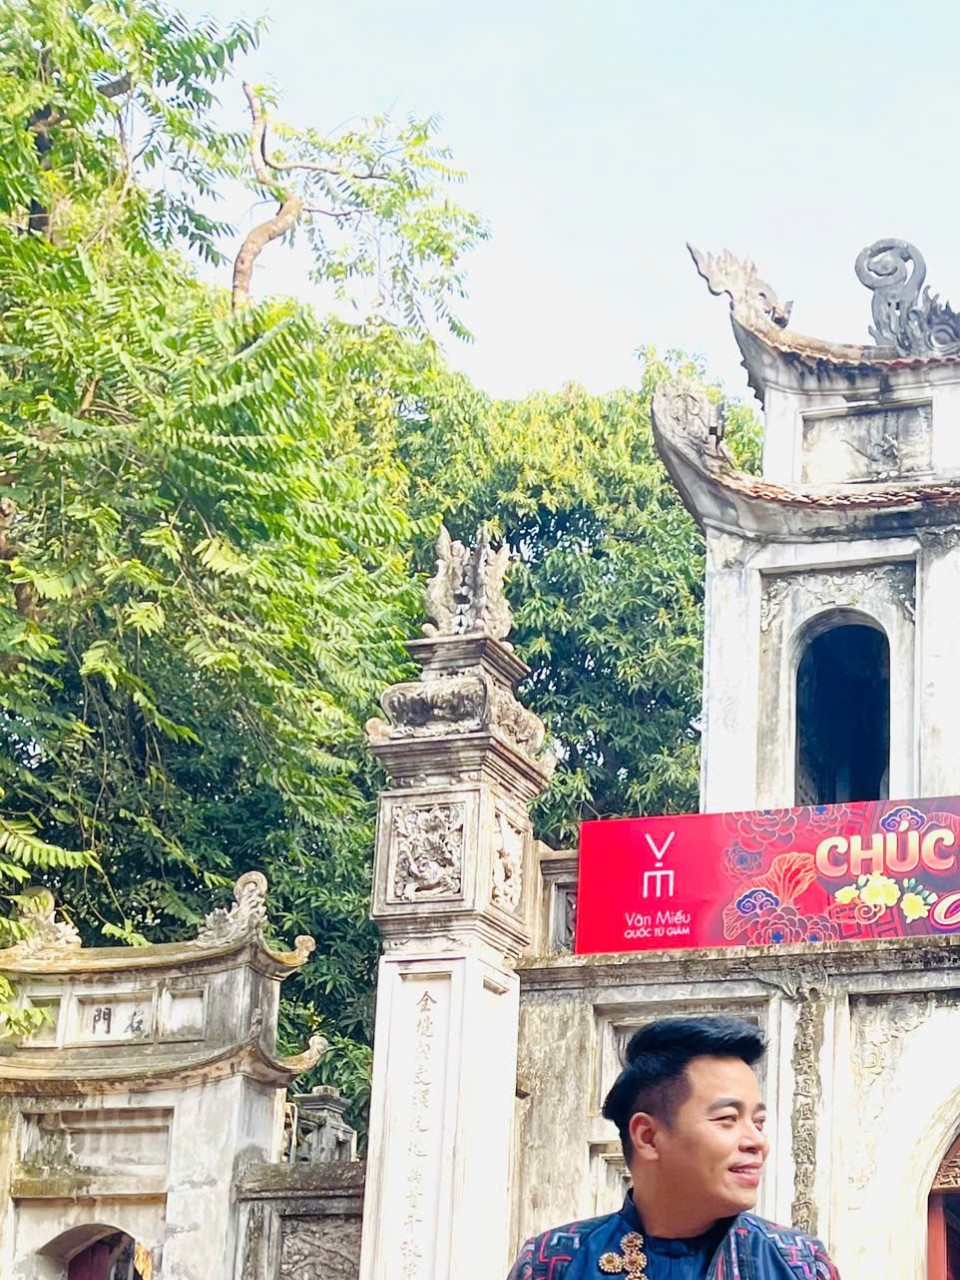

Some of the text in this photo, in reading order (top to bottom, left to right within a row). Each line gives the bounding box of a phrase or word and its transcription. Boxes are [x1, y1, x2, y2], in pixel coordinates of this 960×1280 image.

[815, 820, 957, 877] CHÚC
[625, 908, 692, 927] Văn Miếu
